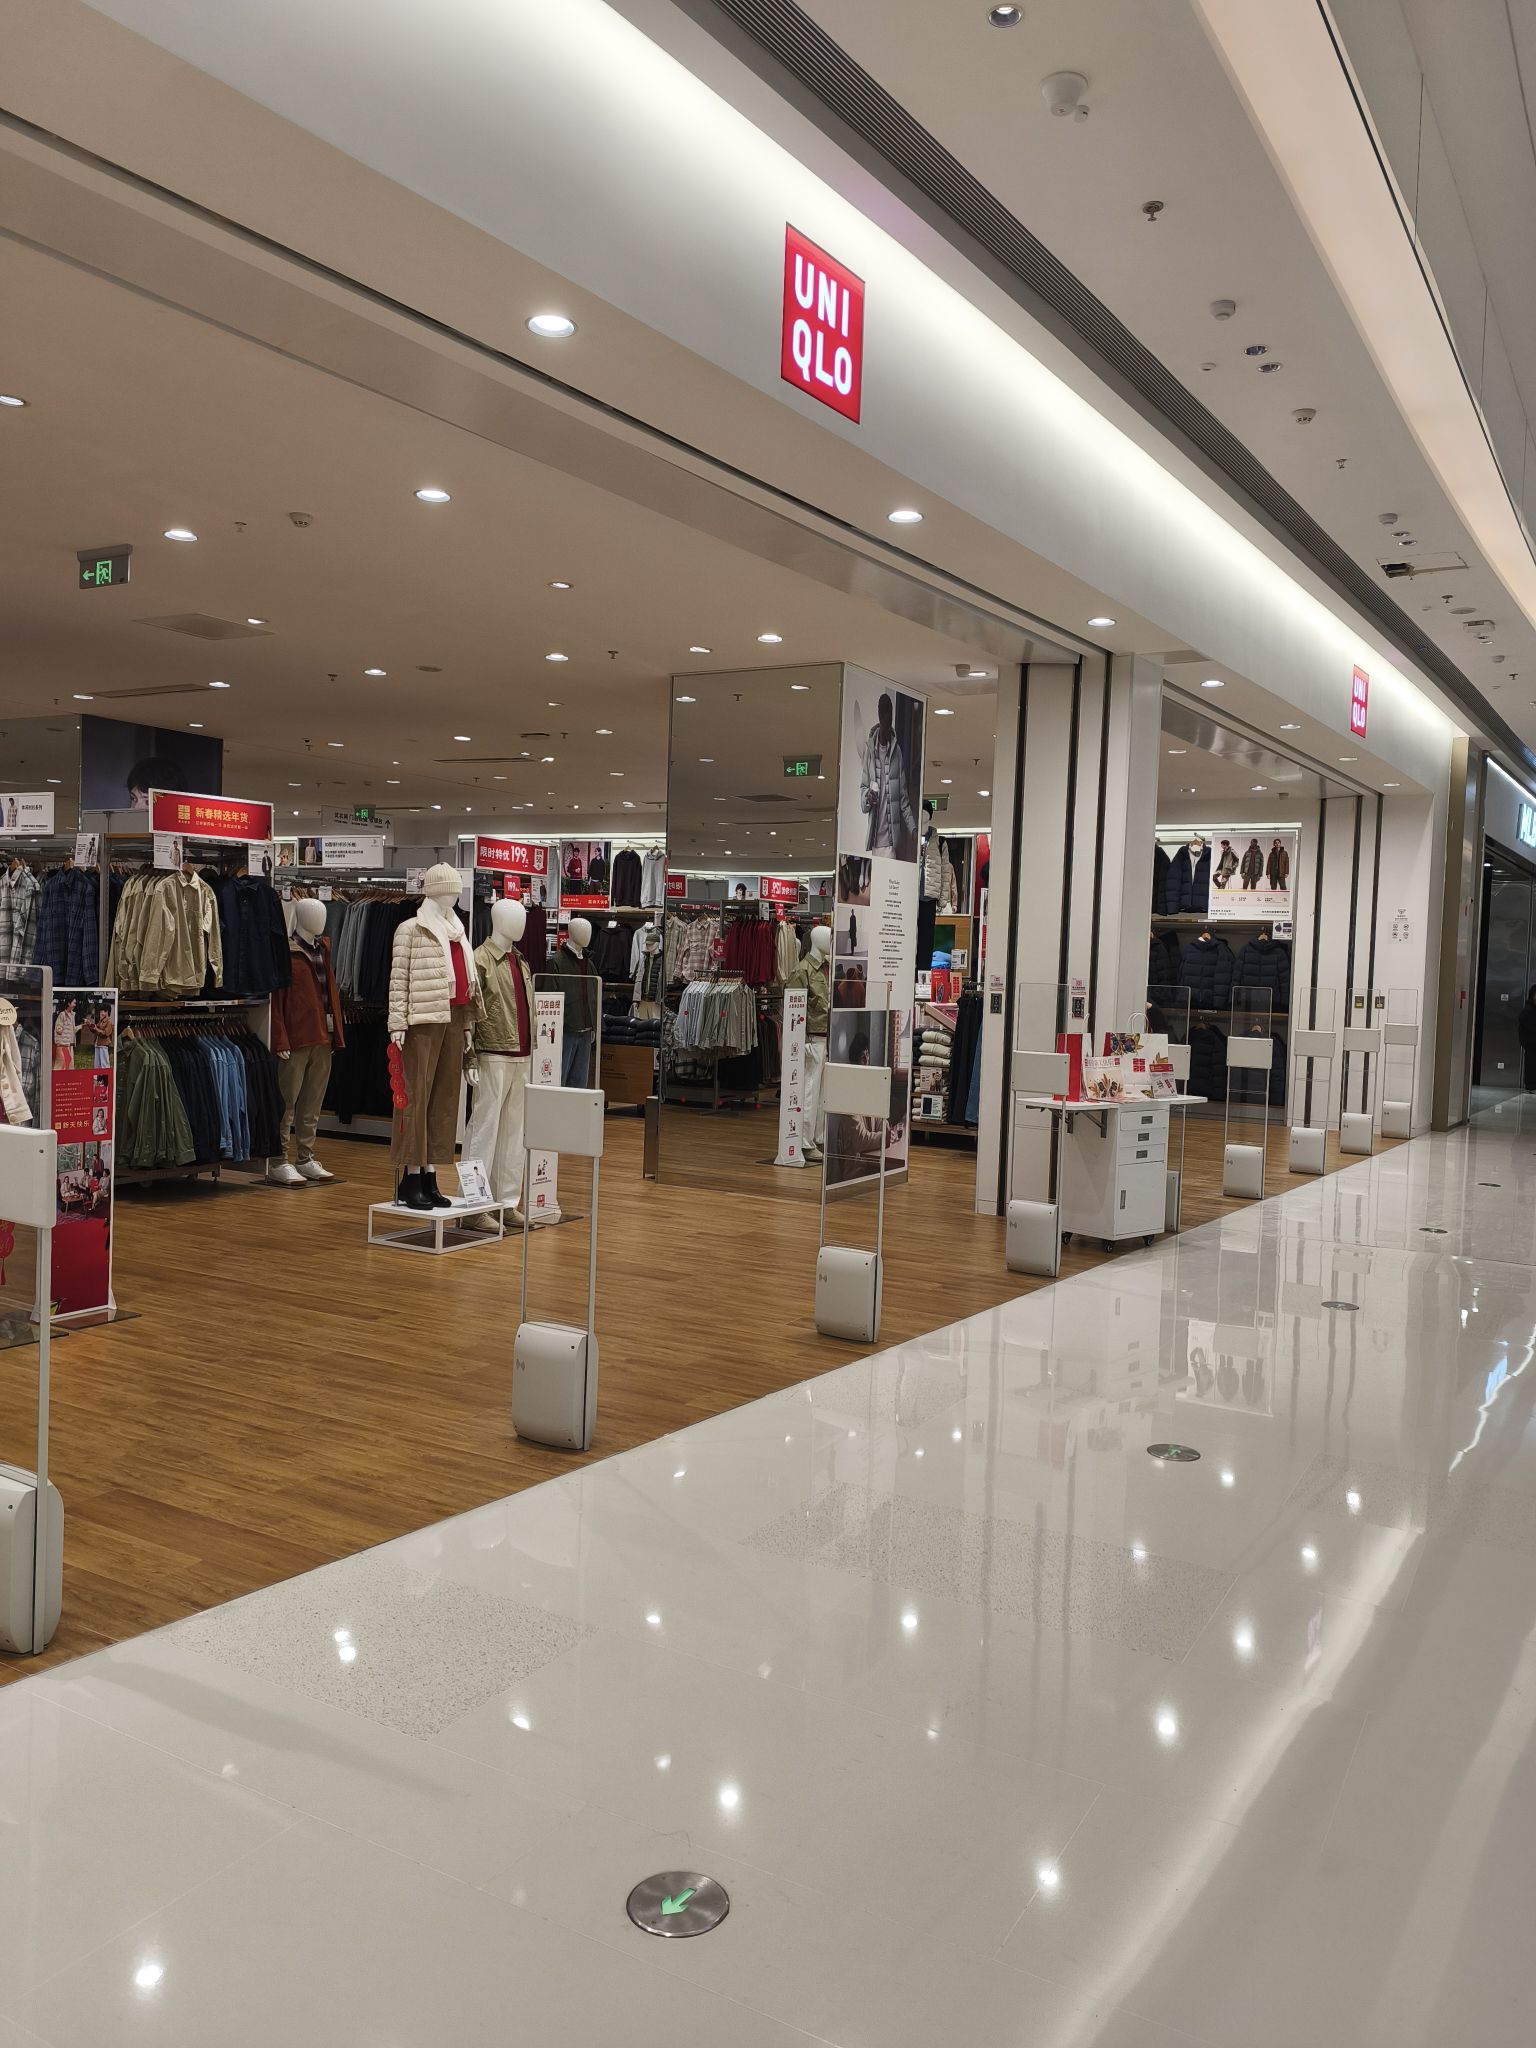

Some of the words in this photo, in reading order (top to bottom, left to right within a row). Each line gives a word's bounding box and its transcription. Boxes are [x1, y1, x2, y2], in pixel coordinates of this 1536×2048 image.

[794, 253, 850, 338] UNI
[792, 318, 853, 396] QLO
[1353, 701, 1365, 728] QLO
[1354, 675, 1366, 703] UNI
